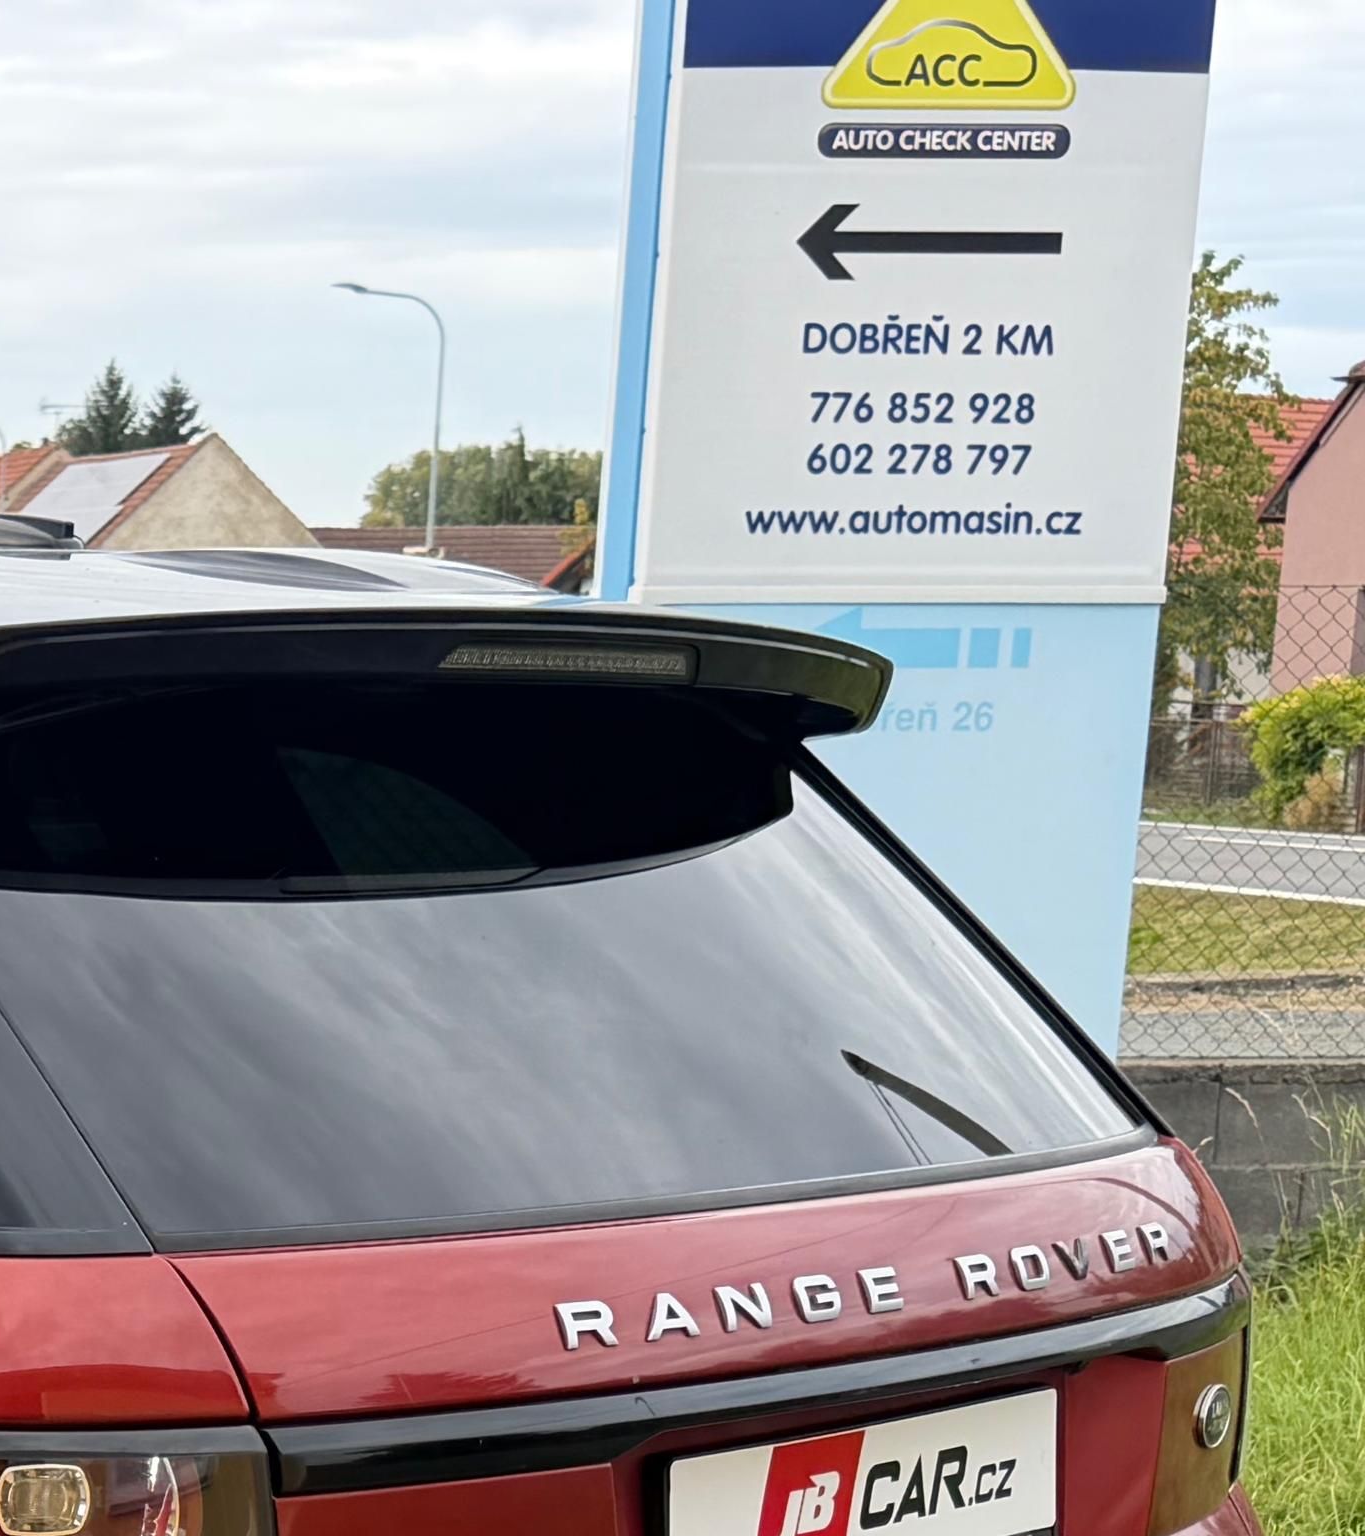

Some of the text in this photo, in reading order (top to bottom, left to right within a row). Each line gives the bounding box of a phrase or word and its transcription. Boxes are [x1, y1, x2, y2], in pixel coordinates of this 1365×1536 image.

[905, 53, 982, 87] ACC
[832, 130, 1056, 151] AUTO CHECK CENTER
[802, 315, 1054, 356] DOBŘEŇ 2 KM
[810, 392, 1036, 424] 776 852 928
[807, 443, 1032, 475] 602 278 797
[745, 502, 1083, 535] www.automasin.cz
[880, 701, 994, 732] řeň 26
[554, 1222, 1172, 1351] RANGE ROVER
